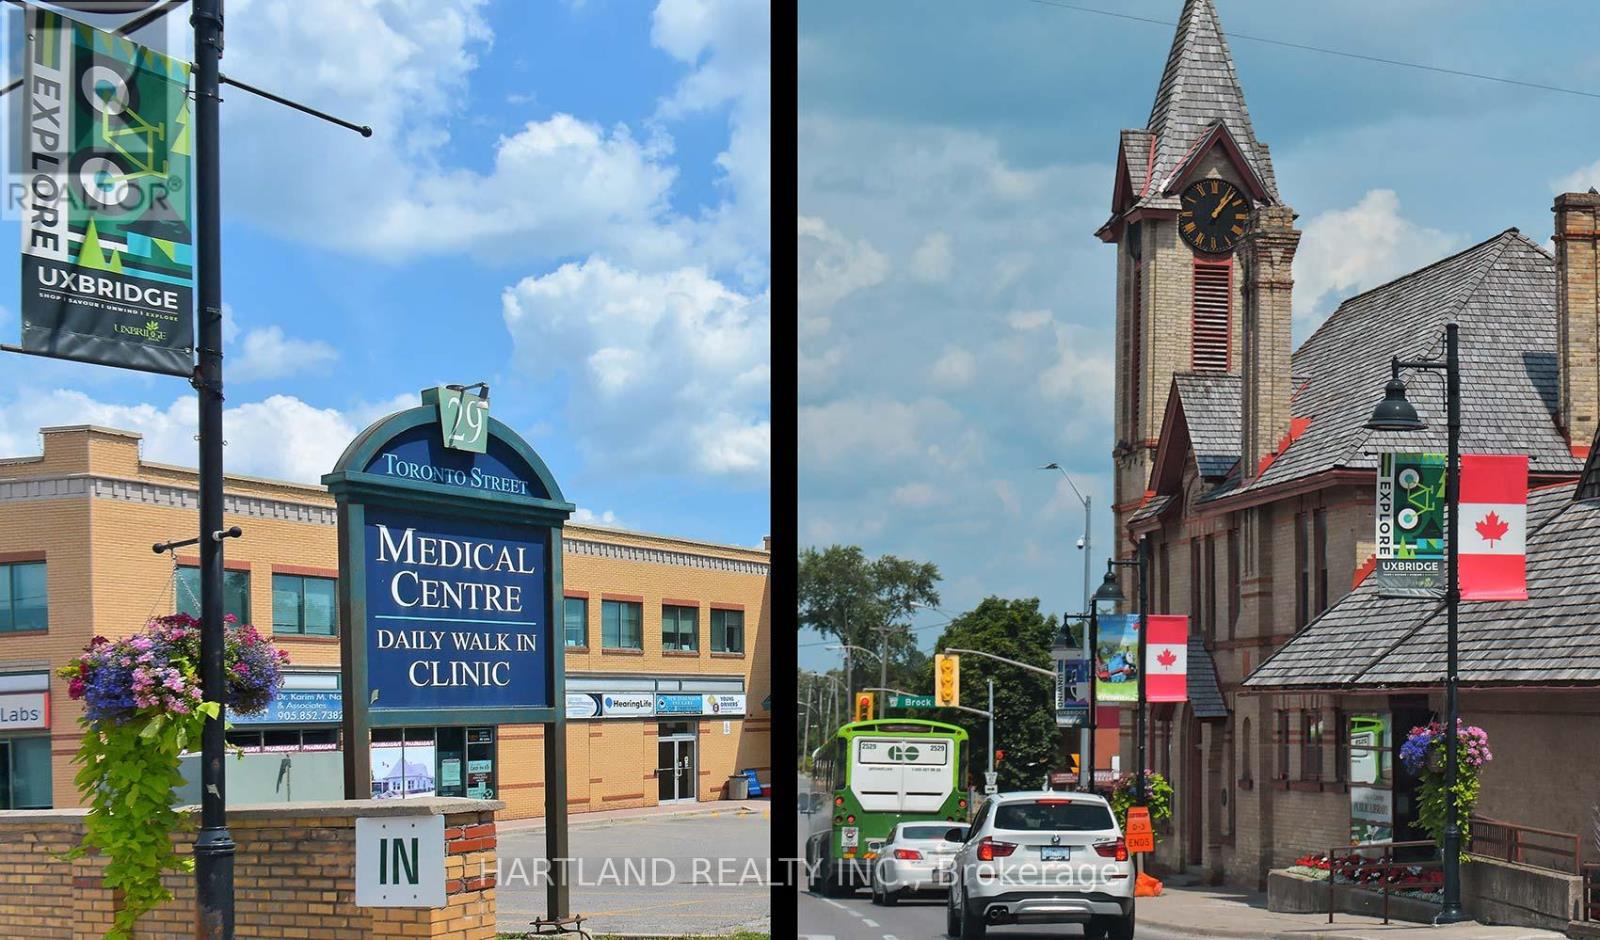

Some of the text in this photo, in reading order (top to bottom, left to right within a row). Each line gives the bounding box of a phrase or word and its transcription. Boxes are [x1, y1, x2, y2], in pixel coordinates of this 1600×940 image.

[31, 74, 61, 253] EXPLORE
[38, 265, 178, 309] UXBRIDGE
[39, 292, 178, 322] SHOP SAVOUR UNWIND EXPLORE
[447, 396, 485, 444] 29
[383, 453, 528, 495] TORONTO STREET
[1379, 481, 1391, 556] EXPLORE
[376, 524, 535, 575] MEDICAL
[1382, 562, 1439, 571] UXBRIDGE
[391, 570, 523, 613] CENTRE
[377, 629, 536, 652] DAILY WALK IN
[408, 660, 511, 688] CLINIC
[286, 701, 327, 709] Associates
[290, 693, 314, 701] Karim
[613, 699, 652, 709] HearingLife
[905, 698, 932, 706] Brock
[1, 707, 39, 722] Labs
[380, 837, 419, 885] IN
